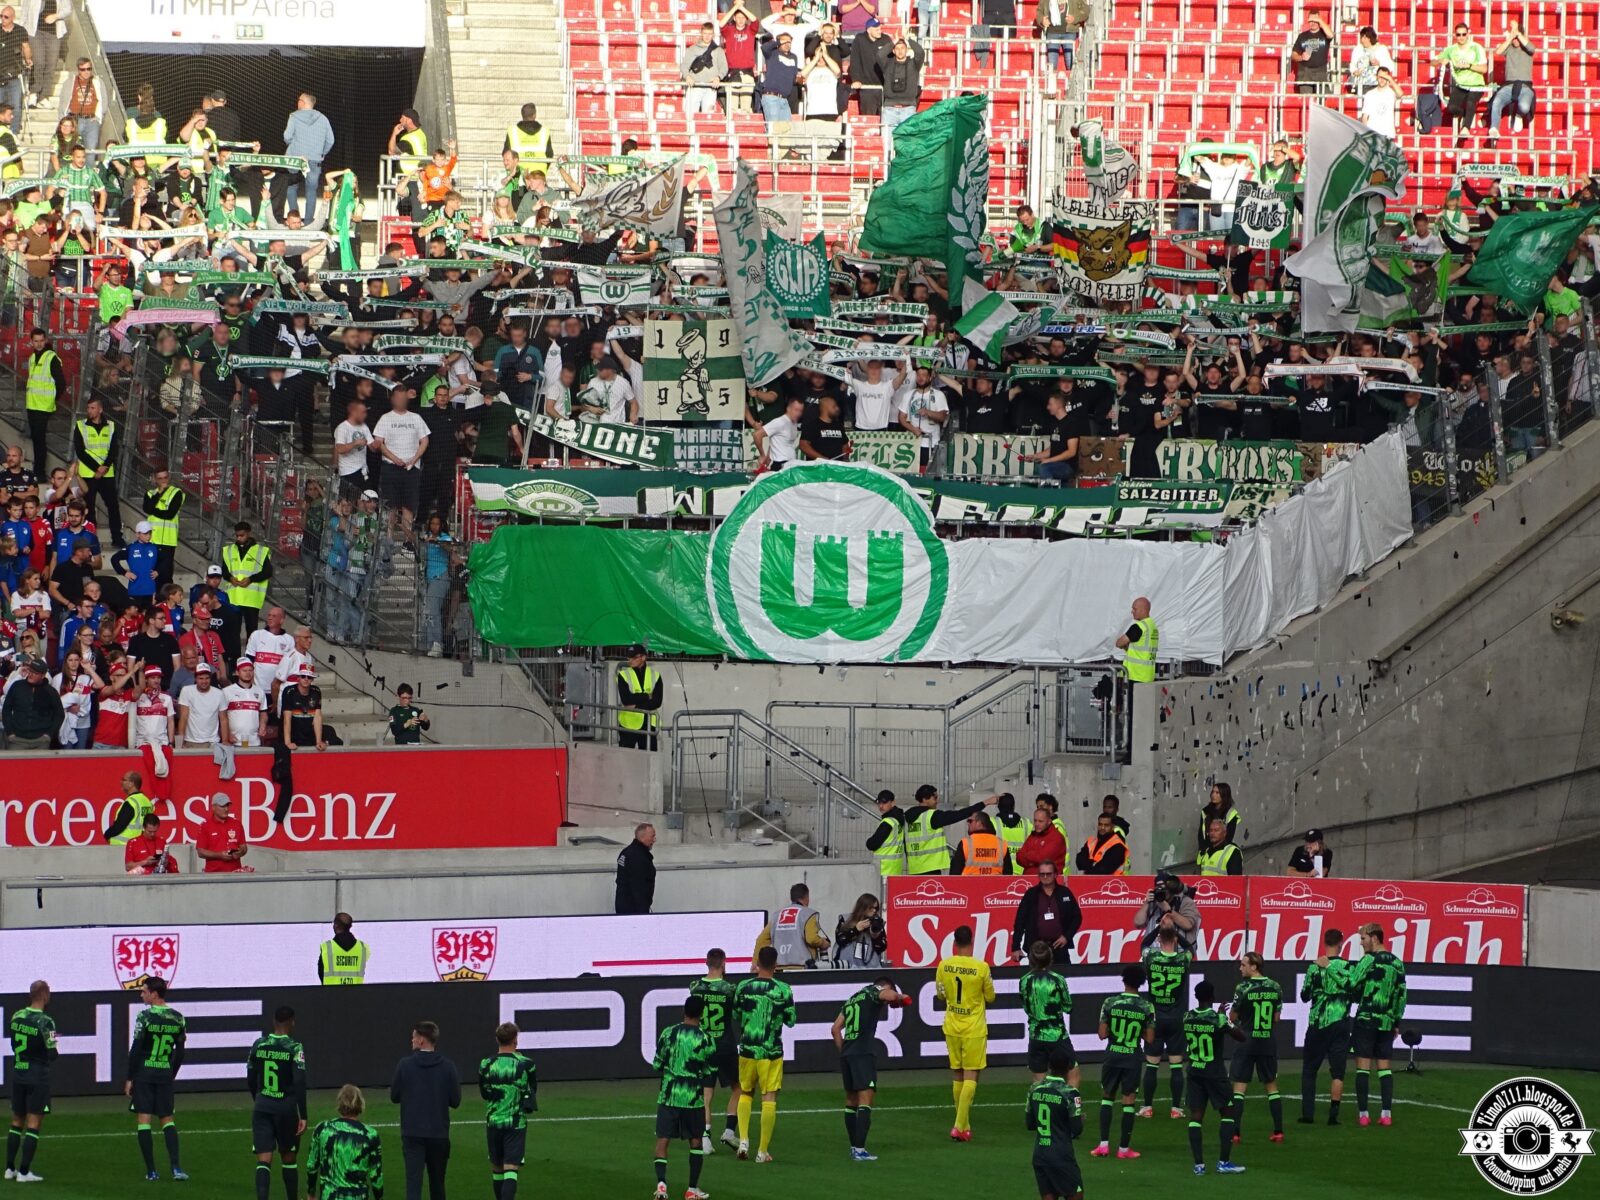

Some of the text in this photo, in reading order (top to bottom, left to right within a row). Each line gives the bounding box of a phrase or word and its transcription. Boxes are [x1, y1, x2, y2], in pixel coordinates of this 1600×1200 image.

[252, 0, 334, 18] Arena
[1250, 237, 1270, 247] 1945
[286, 301, 340, 312] WOLFSBURG
[673, 446, 744, 460] WAPPEN
[1119, 488, 1219, 501] SALZGITTER
[975, 847, 998, 858] SECURITY
[895, 897, 966, 907] Schwarzwaldmilch
[1262, 898, 1334, 909] Schwarzwaldmilch
[1353, 901, 1426, 912] Schwarzwaldmilch
[1444, 904, 1517, 916] Schwarzwaldmilch
[435, 929, 495, 964] VfB
[780, 944, 792, 954] 07
[116, 937, 177, 972] VfB
[335, 955, 358, 967] SECURITY
[943, 963, 978, 977] WOLFSBURG
[1150, 963, 1185, 974] WOLFSBURG
[955, 975, 963, 1004] 1
[1151, 973, 1182, 997] 27
[1246, 992, 1279, 1001] WOLFSBURG
[845, 1003, 861, 1035] 21
[1110, 1009, 1145, 1021] WOLFSBURG
[1252, 1001, 1273, 1030] 19
[1110, 1020, 1141, 1048] 40
[15, 1033, 28, 1062] 2
[151, 1034, 174, 1061] 16
[1186, 1032, 1213, 1062] 20
[256, 1049, 291, 1061] WOLFSBURG
[263, 1060, 279, 1092] 6
[1031, 1092, 1062, 1105] WOLFSBURG
[1037, 1103, 1051, 1136] 9
